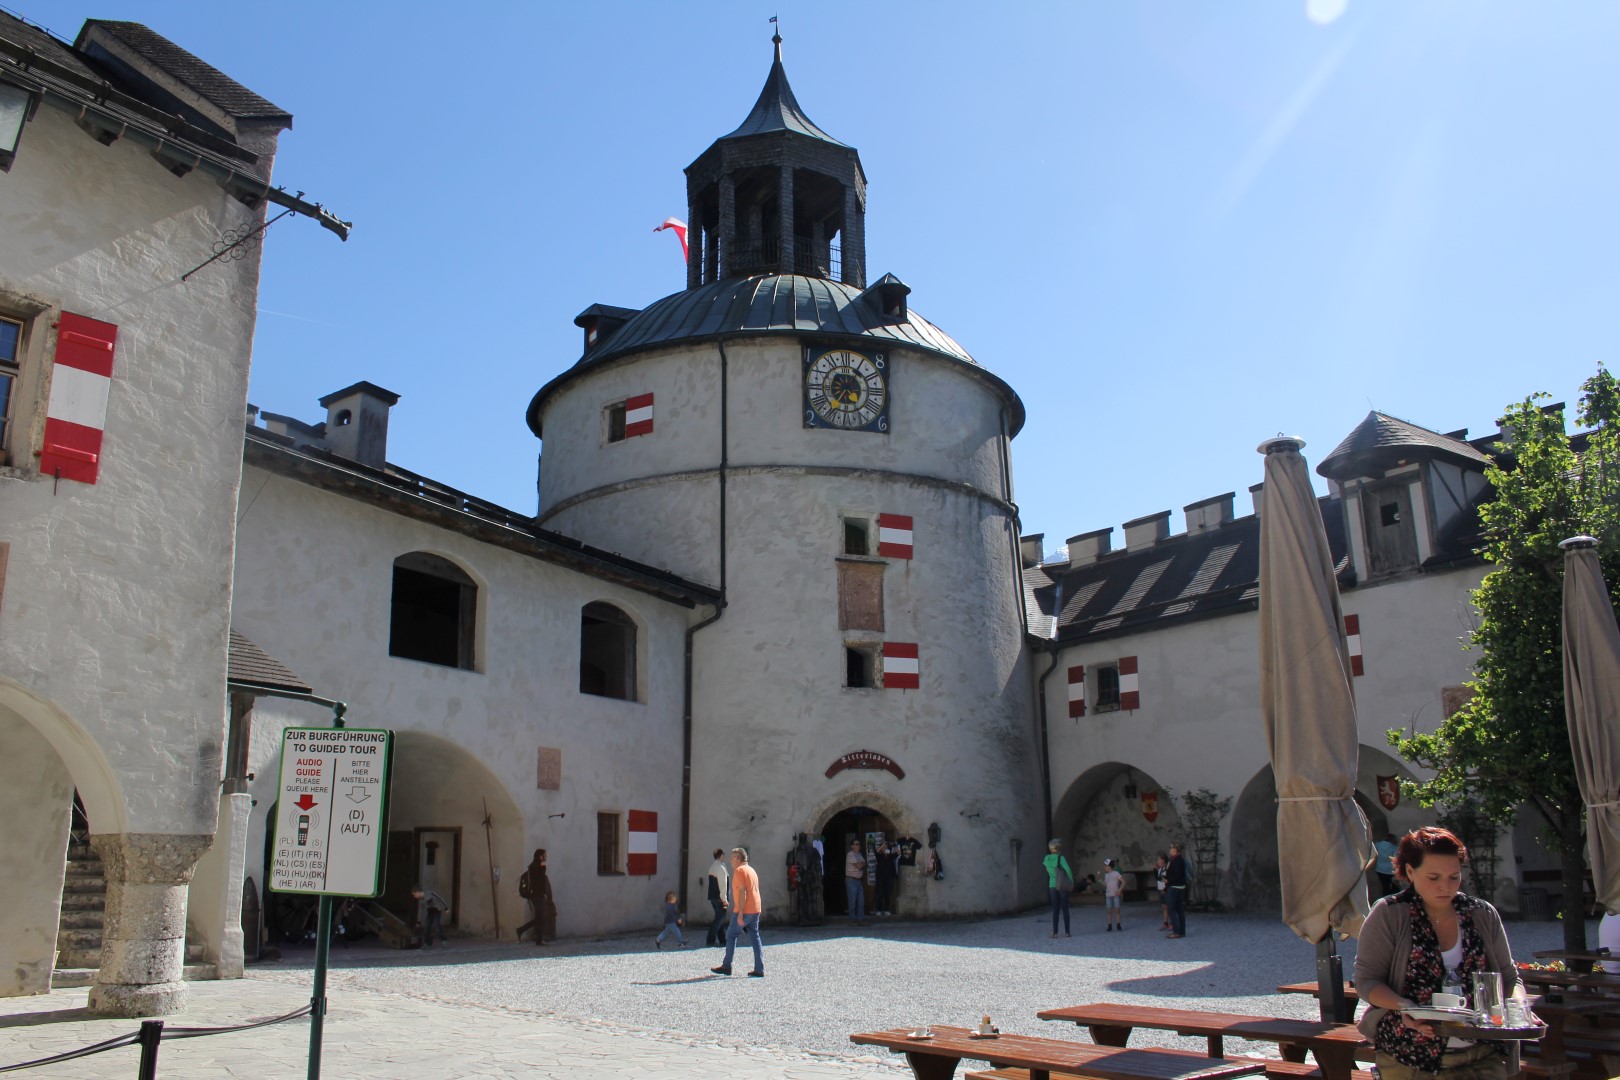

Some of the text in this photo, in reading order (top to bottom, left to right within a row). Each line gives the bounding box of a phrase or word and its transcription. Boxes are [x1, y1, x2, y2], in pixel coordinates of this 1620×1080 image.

[806, 348, 811, 362] 1
[875, 354, 885, 369] 8
[869, 387, 882, 396] III
[805, 410, 816, 426] 2
[877, 415, 887, 431] 6
[286, 731, 386, 743] ZUR BURGFÜHRUNG
[293, 743, 377, 754] TO GUIDED TOUR
[296, 758, 323, 767] AUDIO
[351, 760, 371, 768] BITTE
[296, 768, 322, 777] GUIDE
[295, 777, 321, 785] PLEASE
[340, 776, 380, 784] ANSTELLEN
[285, 785, 329, 794] QUEUE HERE
[348, 809, 365, 822] (D)
[340, 823, 371, 836] (AUT)
[279, 837, 323, 848] (PL) (S)
[278, 849, 322, 860] (E) (IT) (FR)
[273, 859, 326, 870] (NL) (CS) (ES)
[272, 869, 290, 878] (RU)
[299, 881, 316, 889] (AR)
